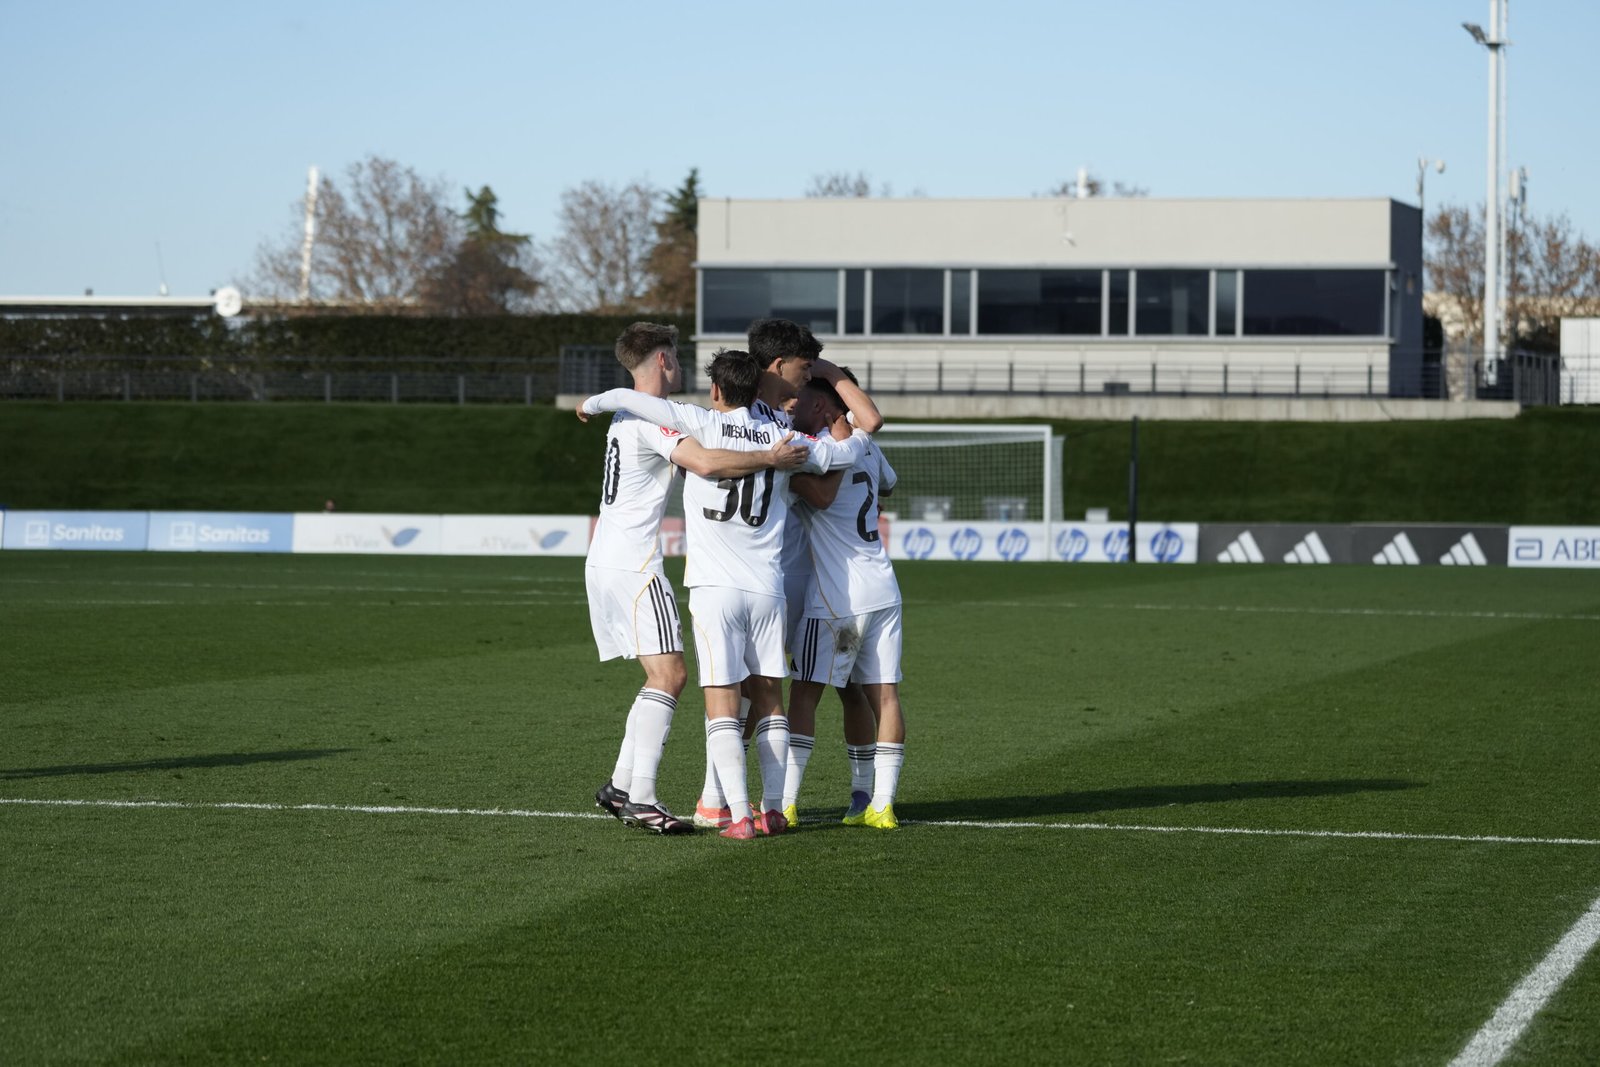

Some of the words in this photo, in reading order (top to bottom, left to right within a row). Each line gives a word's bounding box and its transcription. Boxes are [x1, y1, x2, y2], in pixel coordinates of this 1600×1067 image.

[722, 423, 771, 445] MESONERO
[703, 468, 775, 527] 30
[852, 471, 879, 543] 2
[53, 523, 124, 541] Sanitas
[198, 525, 270, 543] Sanitas
[904, 528, 934, 560] hp
[951, 528, 981, 560] hp
[998, 528, 1028, 561] hp
[1057, 529, 1087, 561] hp
[1151, 529, 1182, 562] hp
